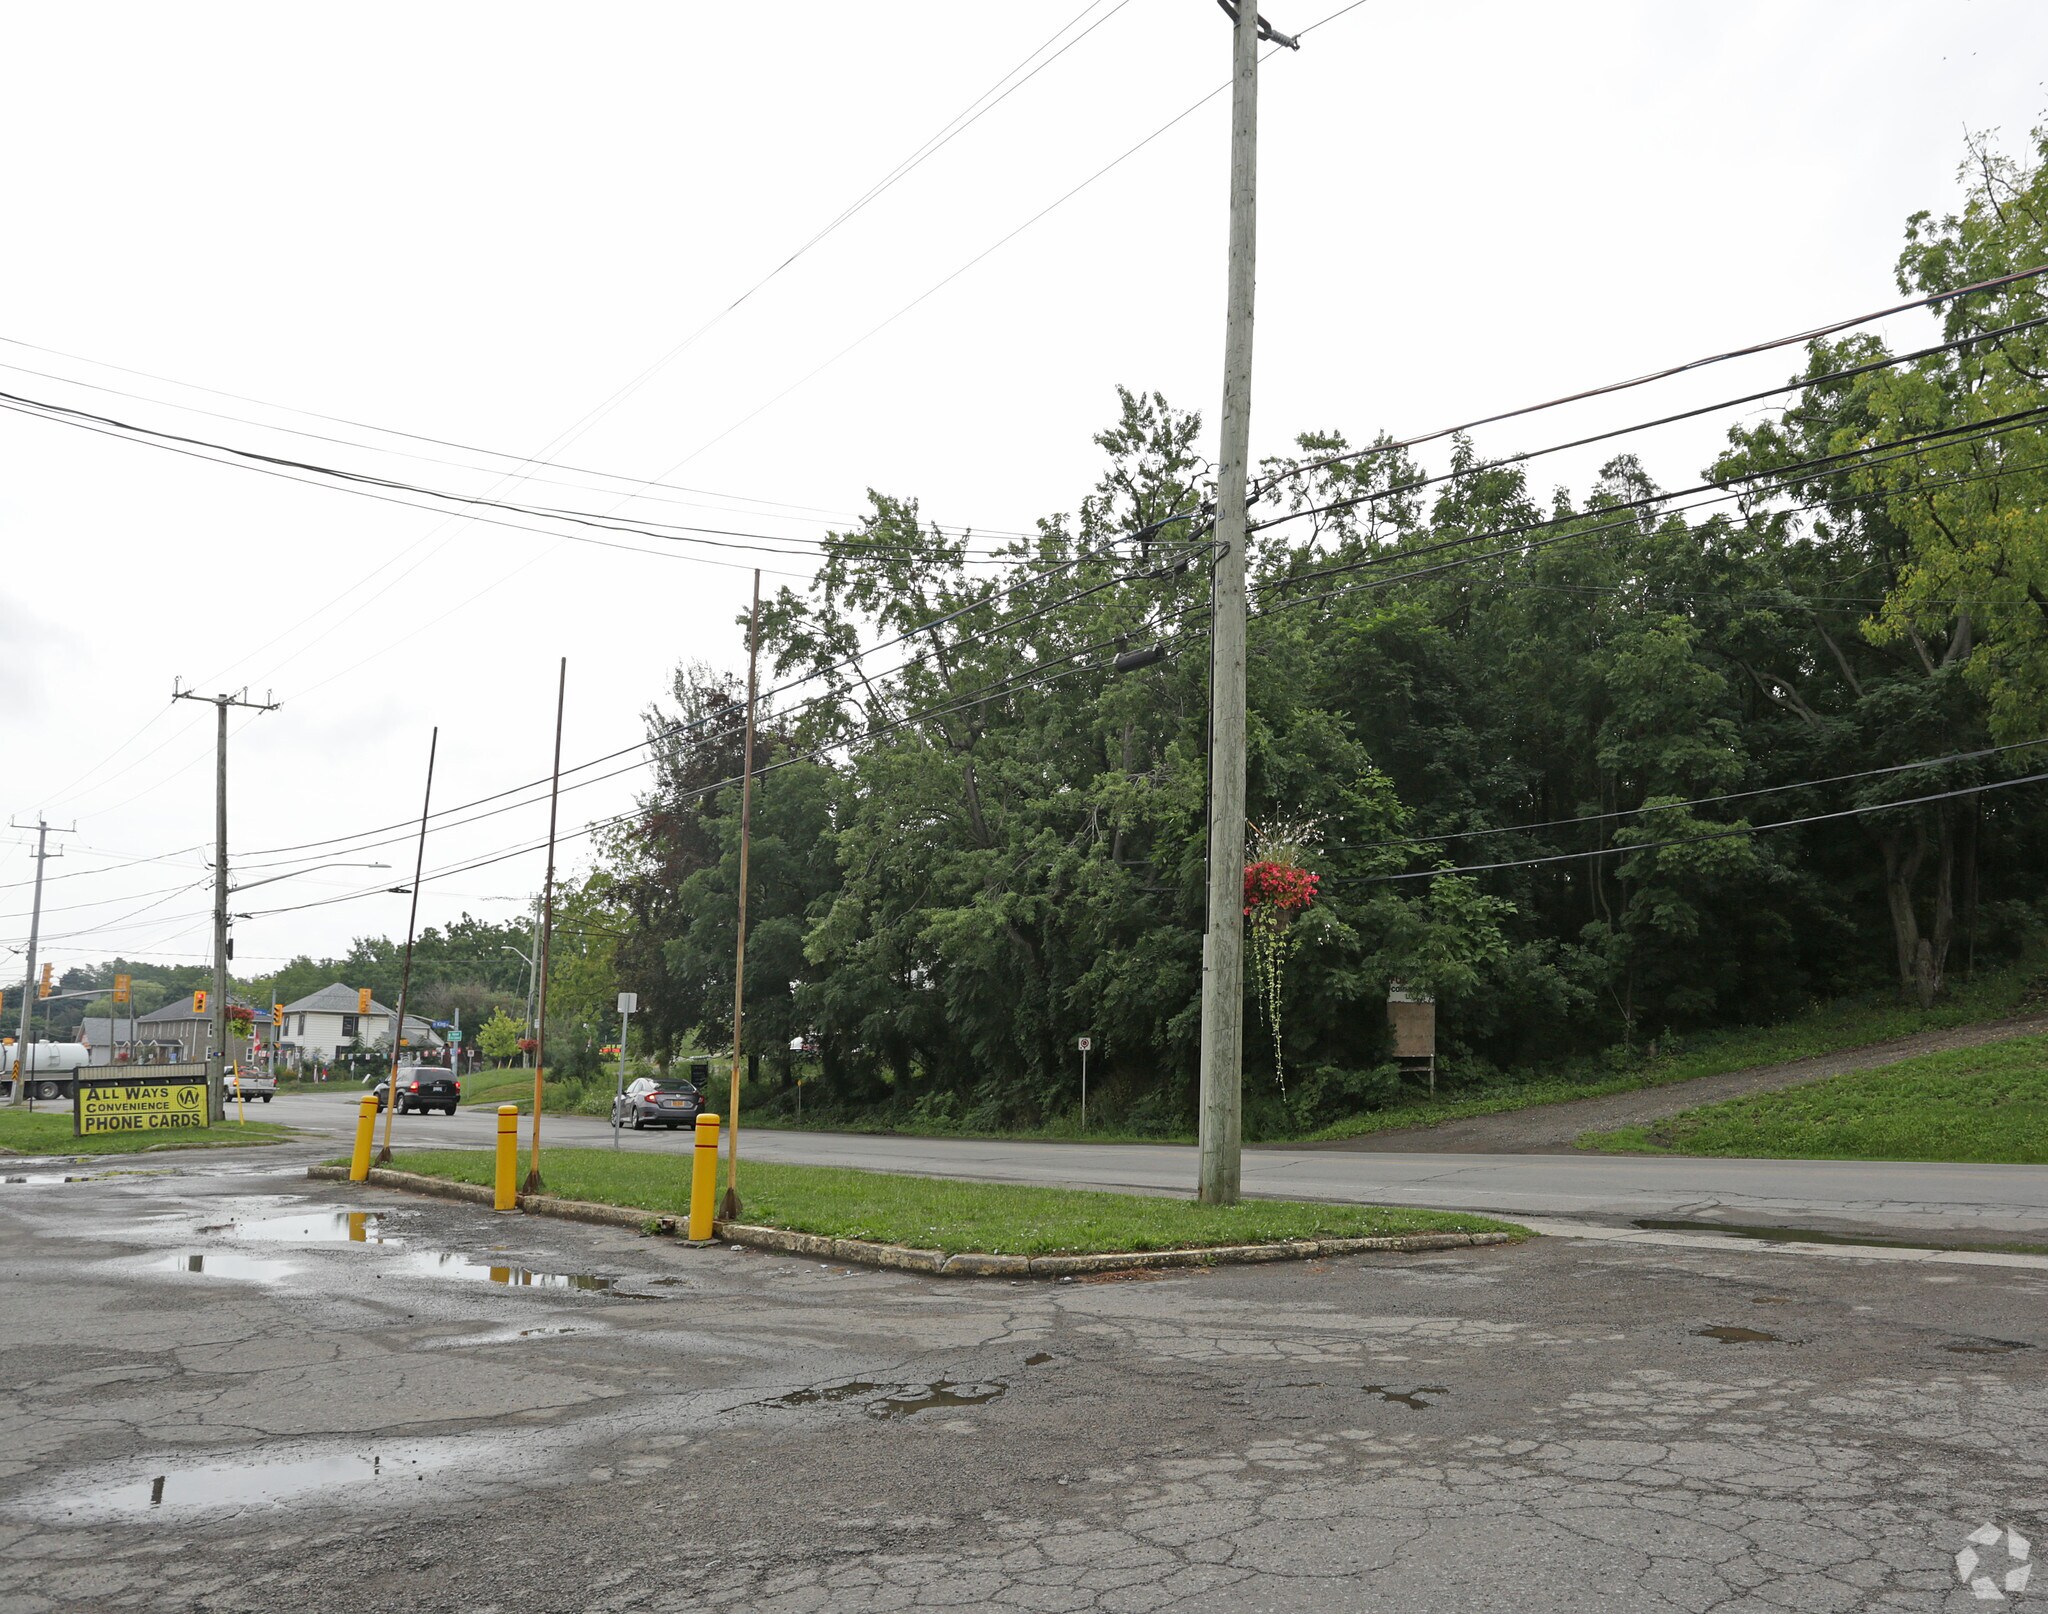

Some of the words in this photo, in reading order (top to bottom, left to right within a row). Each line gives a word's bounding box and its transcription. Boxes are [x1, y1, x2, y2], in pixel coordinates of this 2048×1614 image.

[86, 1088, 119, 1101] ALL
[125, 1087, 169, 1100] WAYS
[86, 1102, 170, 1113] CONVENIENCE
[85, 1116, 143, 1132] PHONE
[148, 1113, 200, 1128] CARDS
